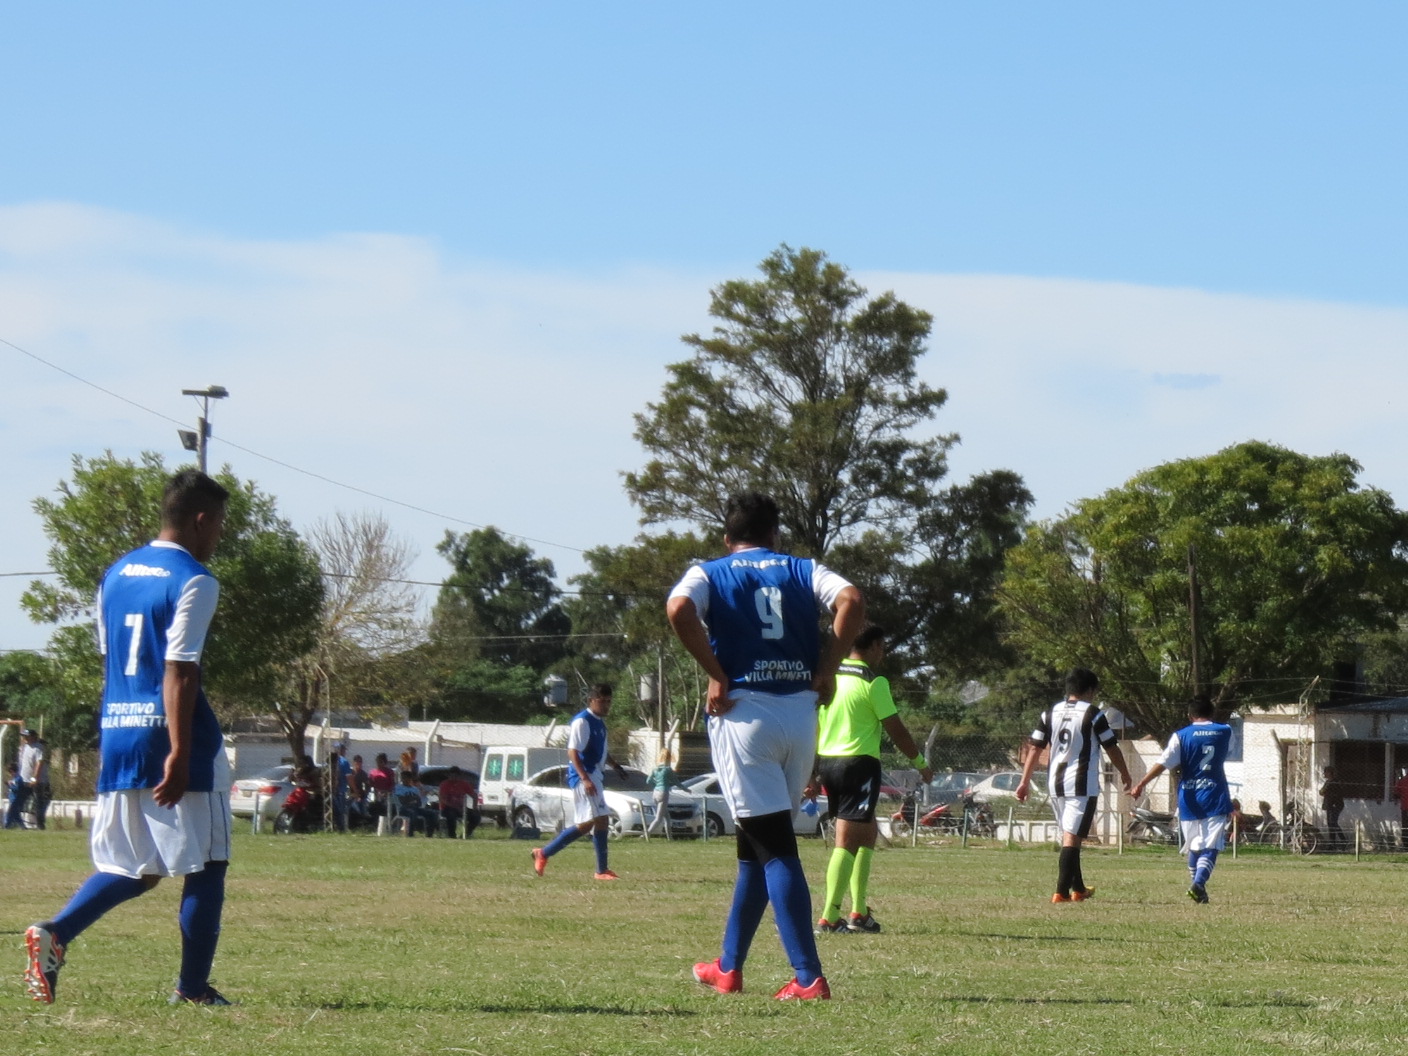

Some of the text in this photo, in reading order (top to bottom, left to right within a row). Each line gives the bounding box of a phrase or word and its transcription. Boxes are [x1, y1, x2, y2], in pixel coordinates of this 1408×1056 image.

[754, 587, 784, 640] 9
[124, 614, 144, 675] 7
[744, 670, 774, 683] VILLA
[1058, 728, 1072, 754] 9
[1200, 744, 1216, 771] 2
